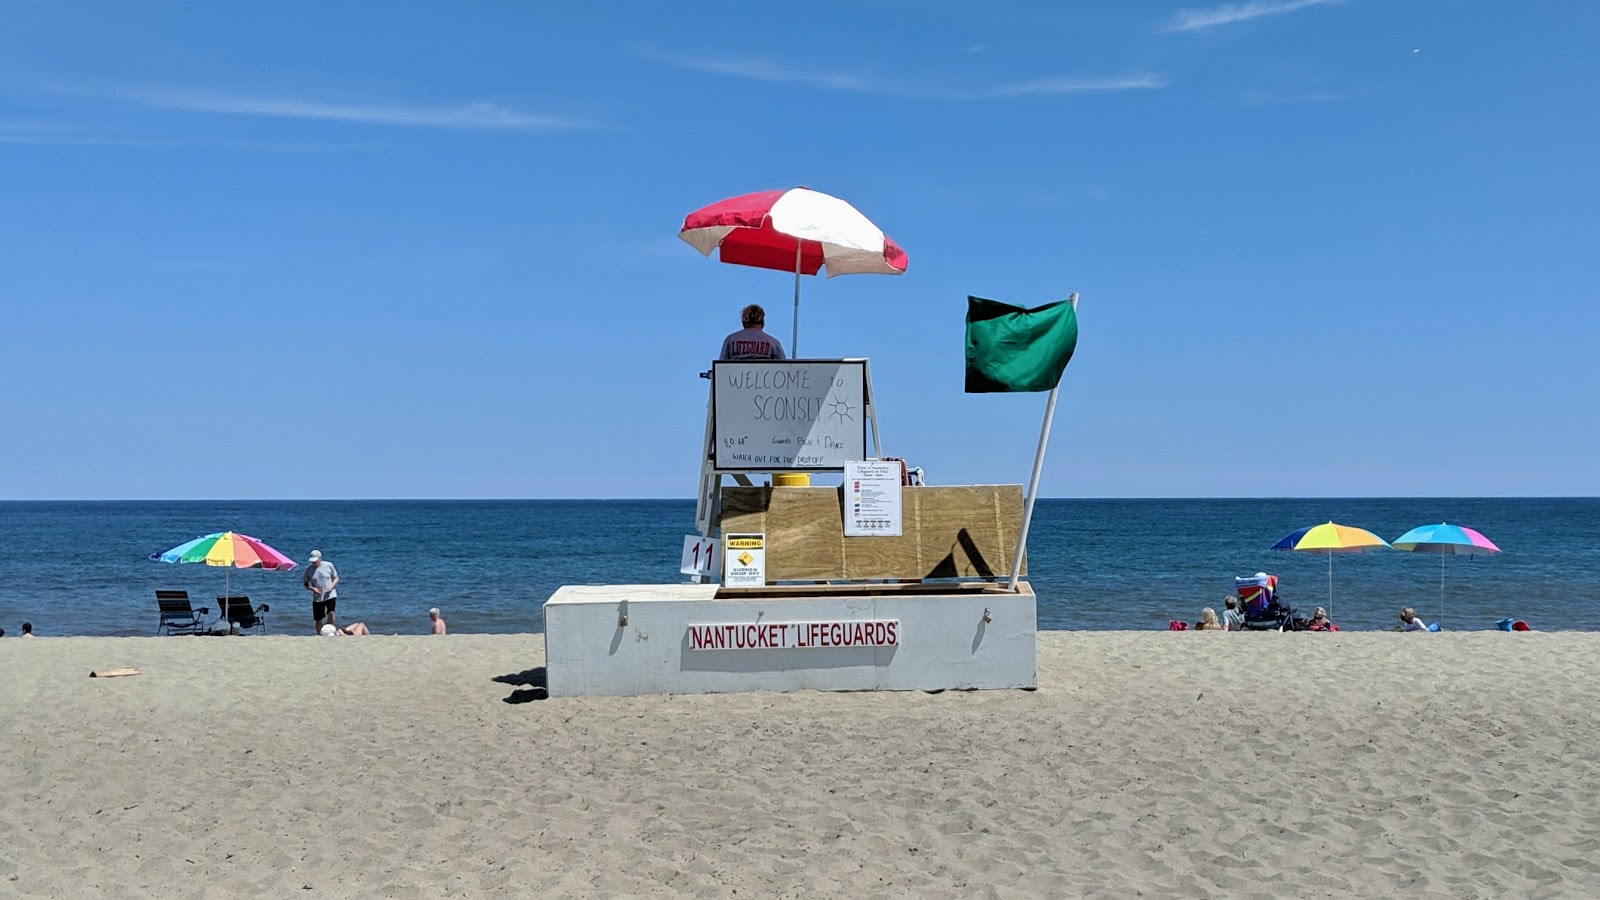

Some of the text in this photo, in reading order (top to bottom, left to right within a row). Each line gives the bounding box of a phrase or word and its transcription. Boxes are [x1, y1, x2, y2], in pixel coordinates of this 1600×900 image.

[731, 340, 770, 356] LIFEGUARD
[728, 370, 811, 389] WELCOME
[754, 395, 822, 421] SCONSET
[732, 453, 752, 462] WATCH
[754, 455, 766, 464] OUT
[769, 455, 781, 464] FOR
[692, 542, 713, 571] 11
[692, 622, 896, 649] NANTUCKET LIFEGUARDS
